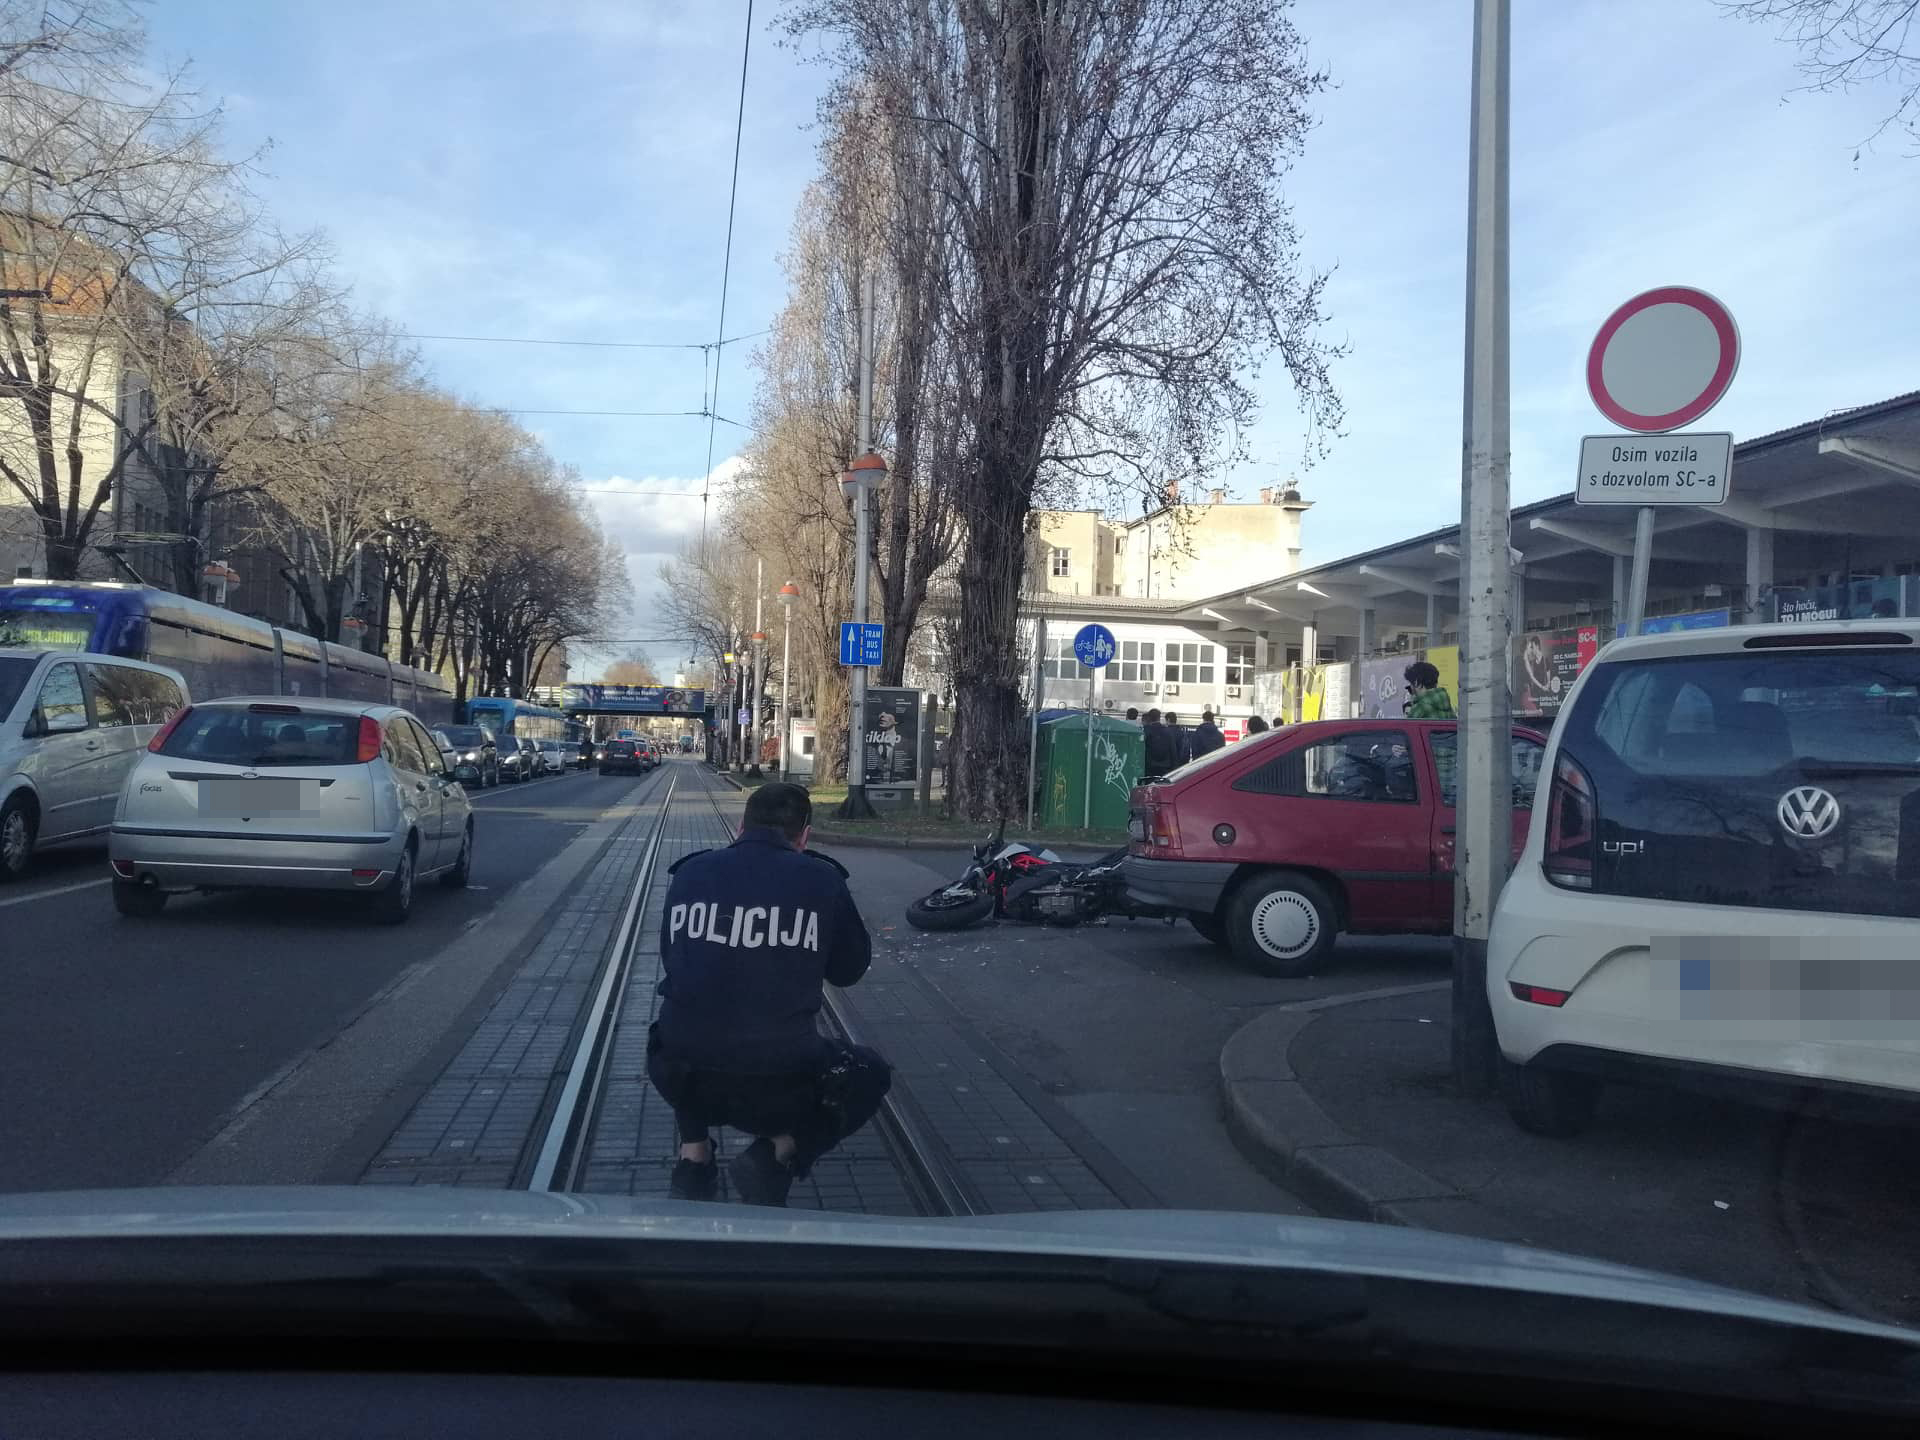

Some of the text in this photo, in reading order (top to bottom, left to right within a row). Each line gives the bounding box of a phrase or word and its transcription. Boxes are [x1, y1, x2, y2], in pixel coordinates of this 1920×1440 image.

[1611, 446, 1698, 462] Osim vozila
[1589, 470, 1716, 487] s dozvolom SC-a
[865, 630, 881, 638] TRAM
[866, 640, 879, 649] BUS
[865, 650, 880, 659] TAXI
[1602, 839, 1646, 857] up!
[669, 902, 818, 952] POLICIJA
